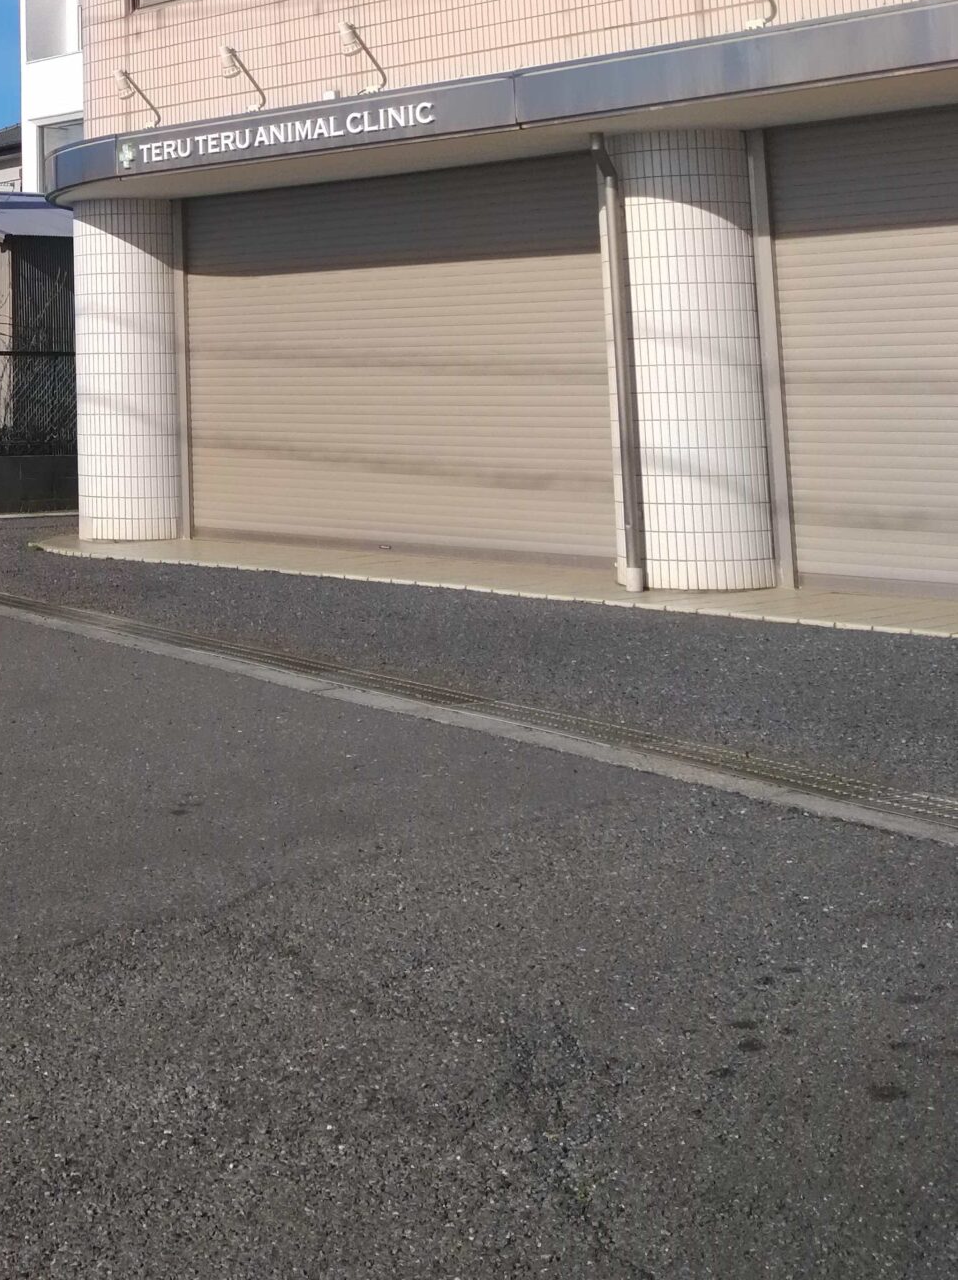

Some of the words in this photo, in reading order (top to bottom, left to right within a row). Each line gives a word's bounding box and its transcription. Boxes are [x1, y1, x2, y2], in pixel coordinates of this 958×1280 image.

[139, 137, 192, 163] TERU
[195, 128, 251, 155] TERU
[254, 117, 344, 147] ANIMAL
[346, 102, 435, 133] CLINIC
